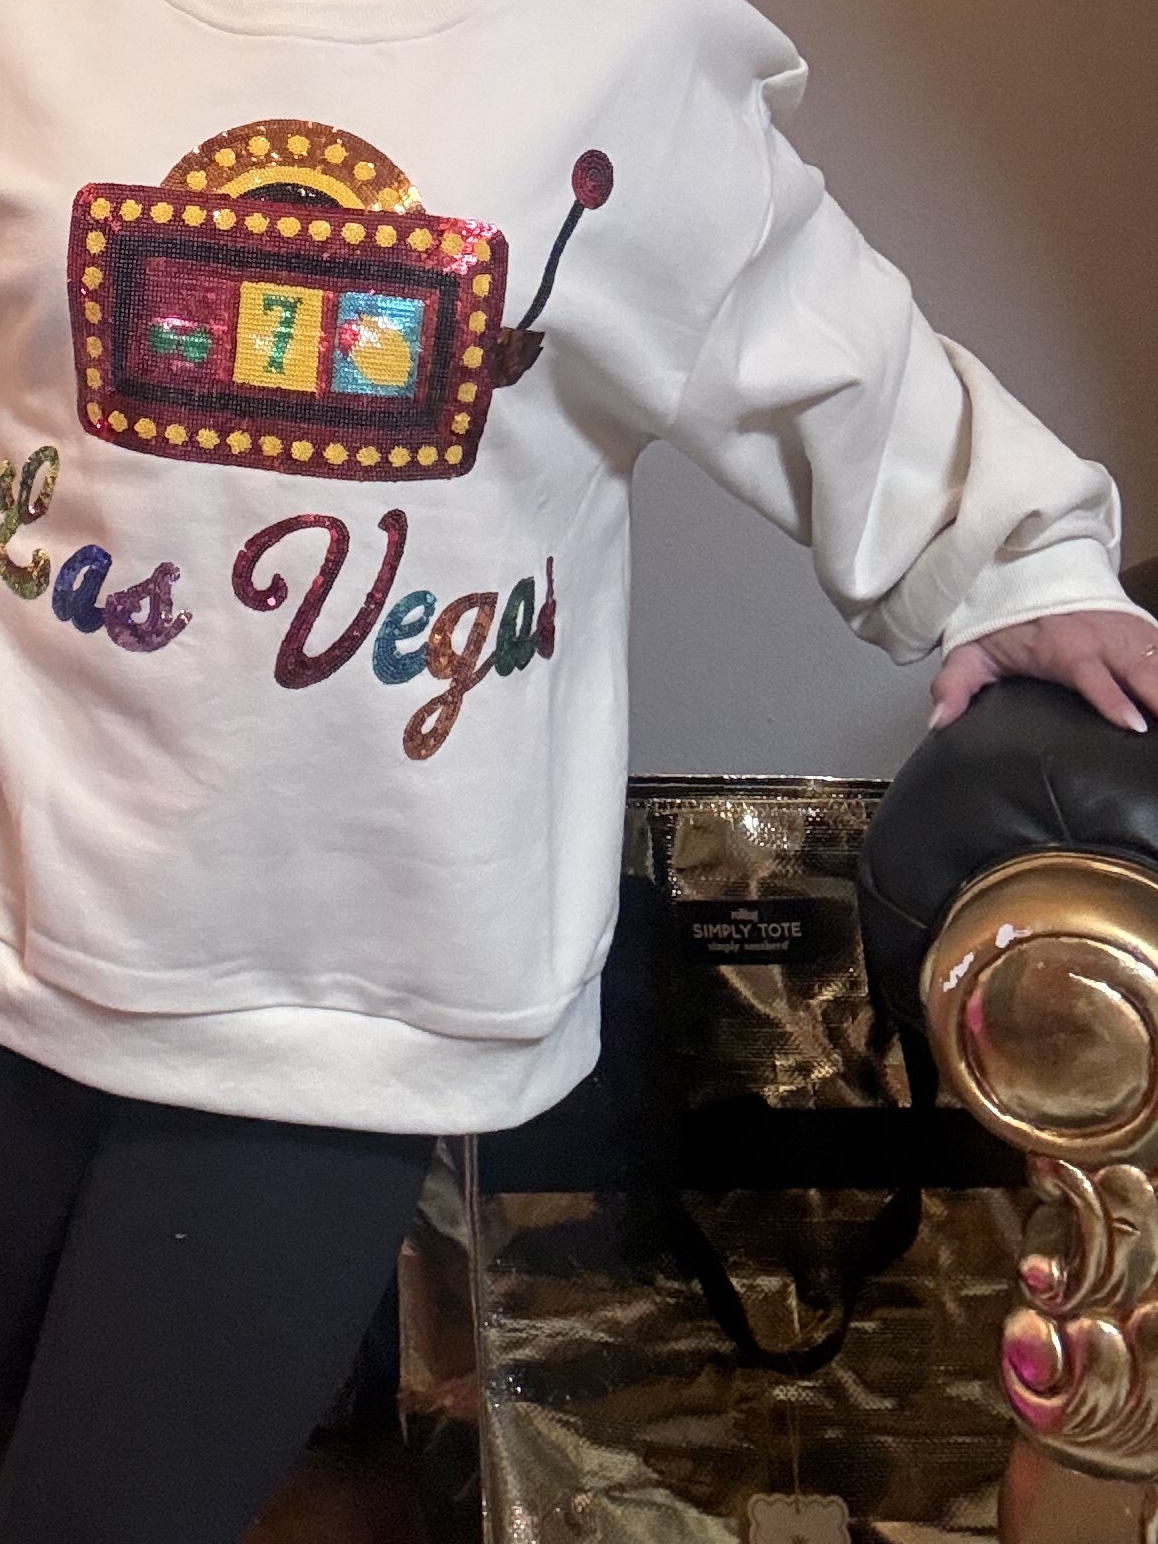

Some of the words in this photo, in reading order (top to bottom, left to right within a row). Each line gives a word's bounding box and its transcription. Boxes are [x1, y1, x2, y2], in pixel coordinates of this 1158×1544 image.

[262, 291, 303, 375] 7
[692, 923, 753, 939] SIMPLY
[757, 922, 803, 938] TOTE
